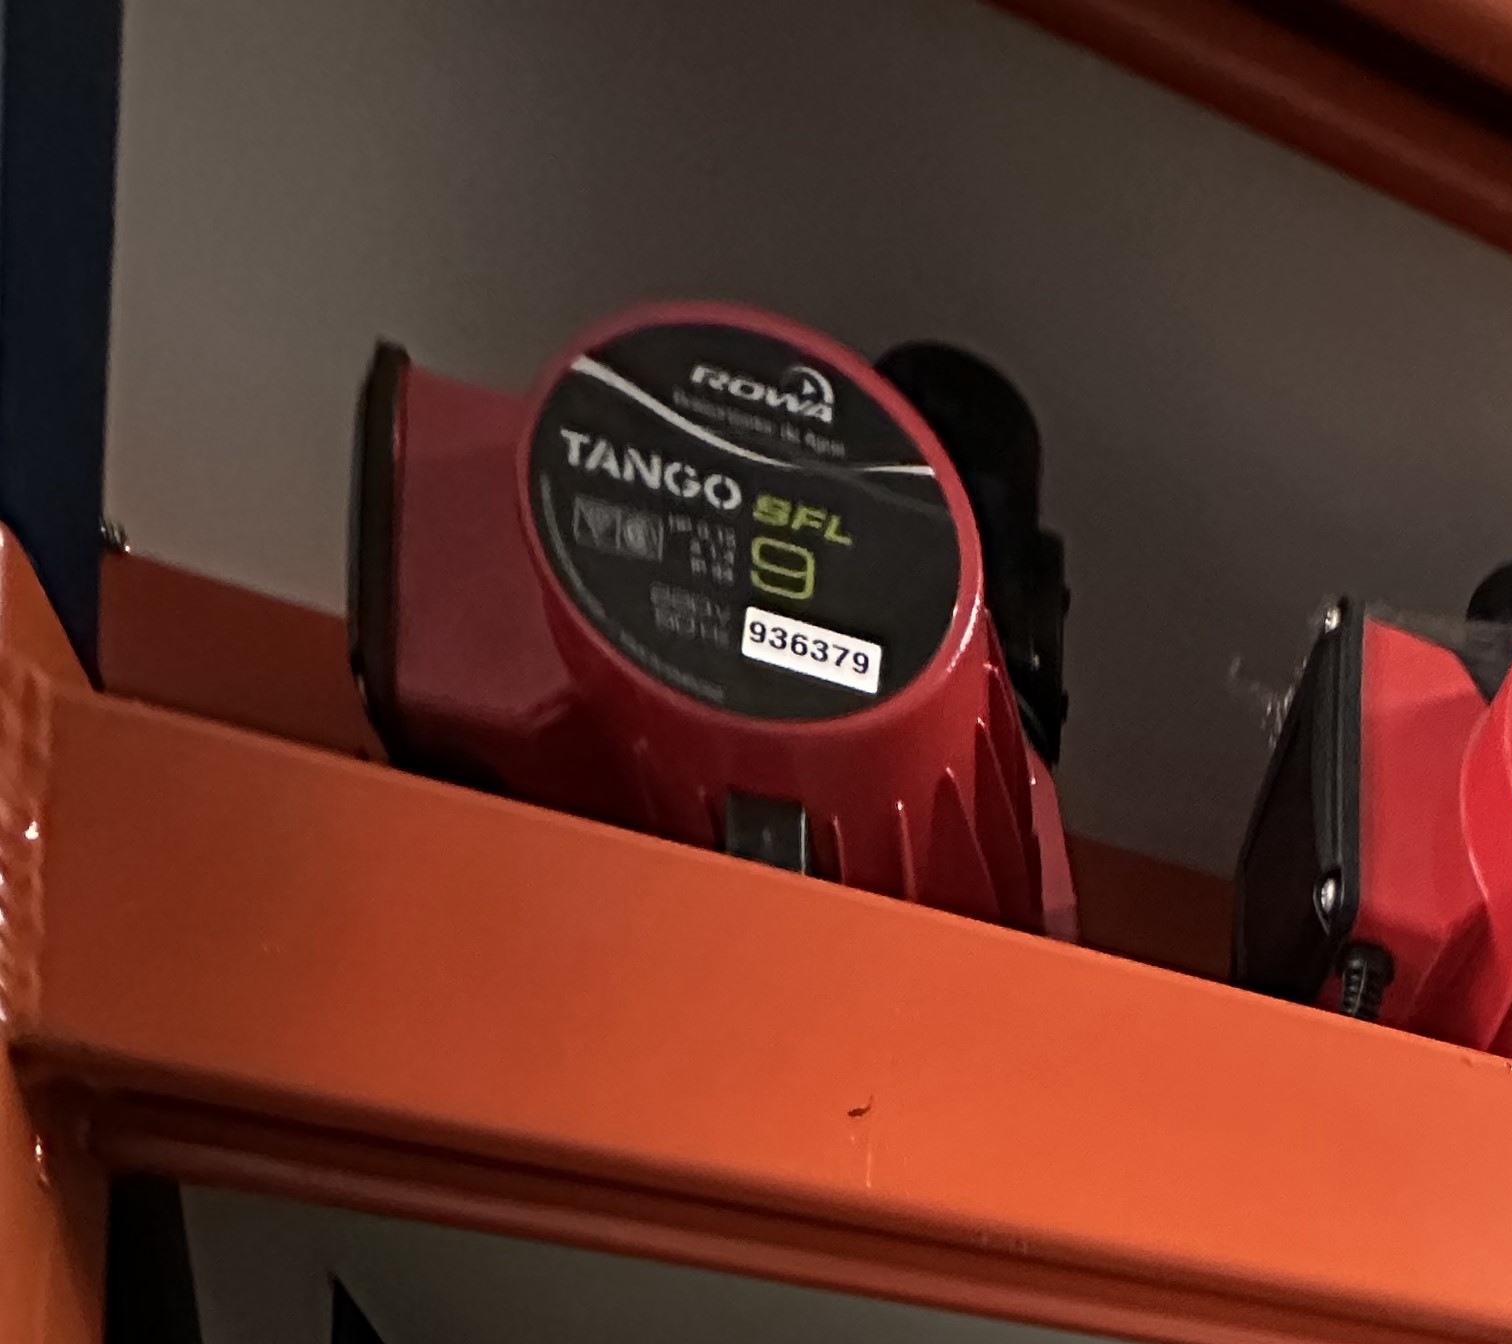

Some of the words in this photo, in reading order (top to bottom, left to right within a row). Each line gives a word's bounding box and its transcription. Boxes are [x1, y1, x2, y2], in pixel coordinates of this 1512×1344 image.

[690, 365, 834, 424] ROWA
[560, 428, 742, 511] TANGO
[753, 494, 853, 547] SFL
[750, 536, 815, 601] 9
[748, 620, 871, 676] 936379
